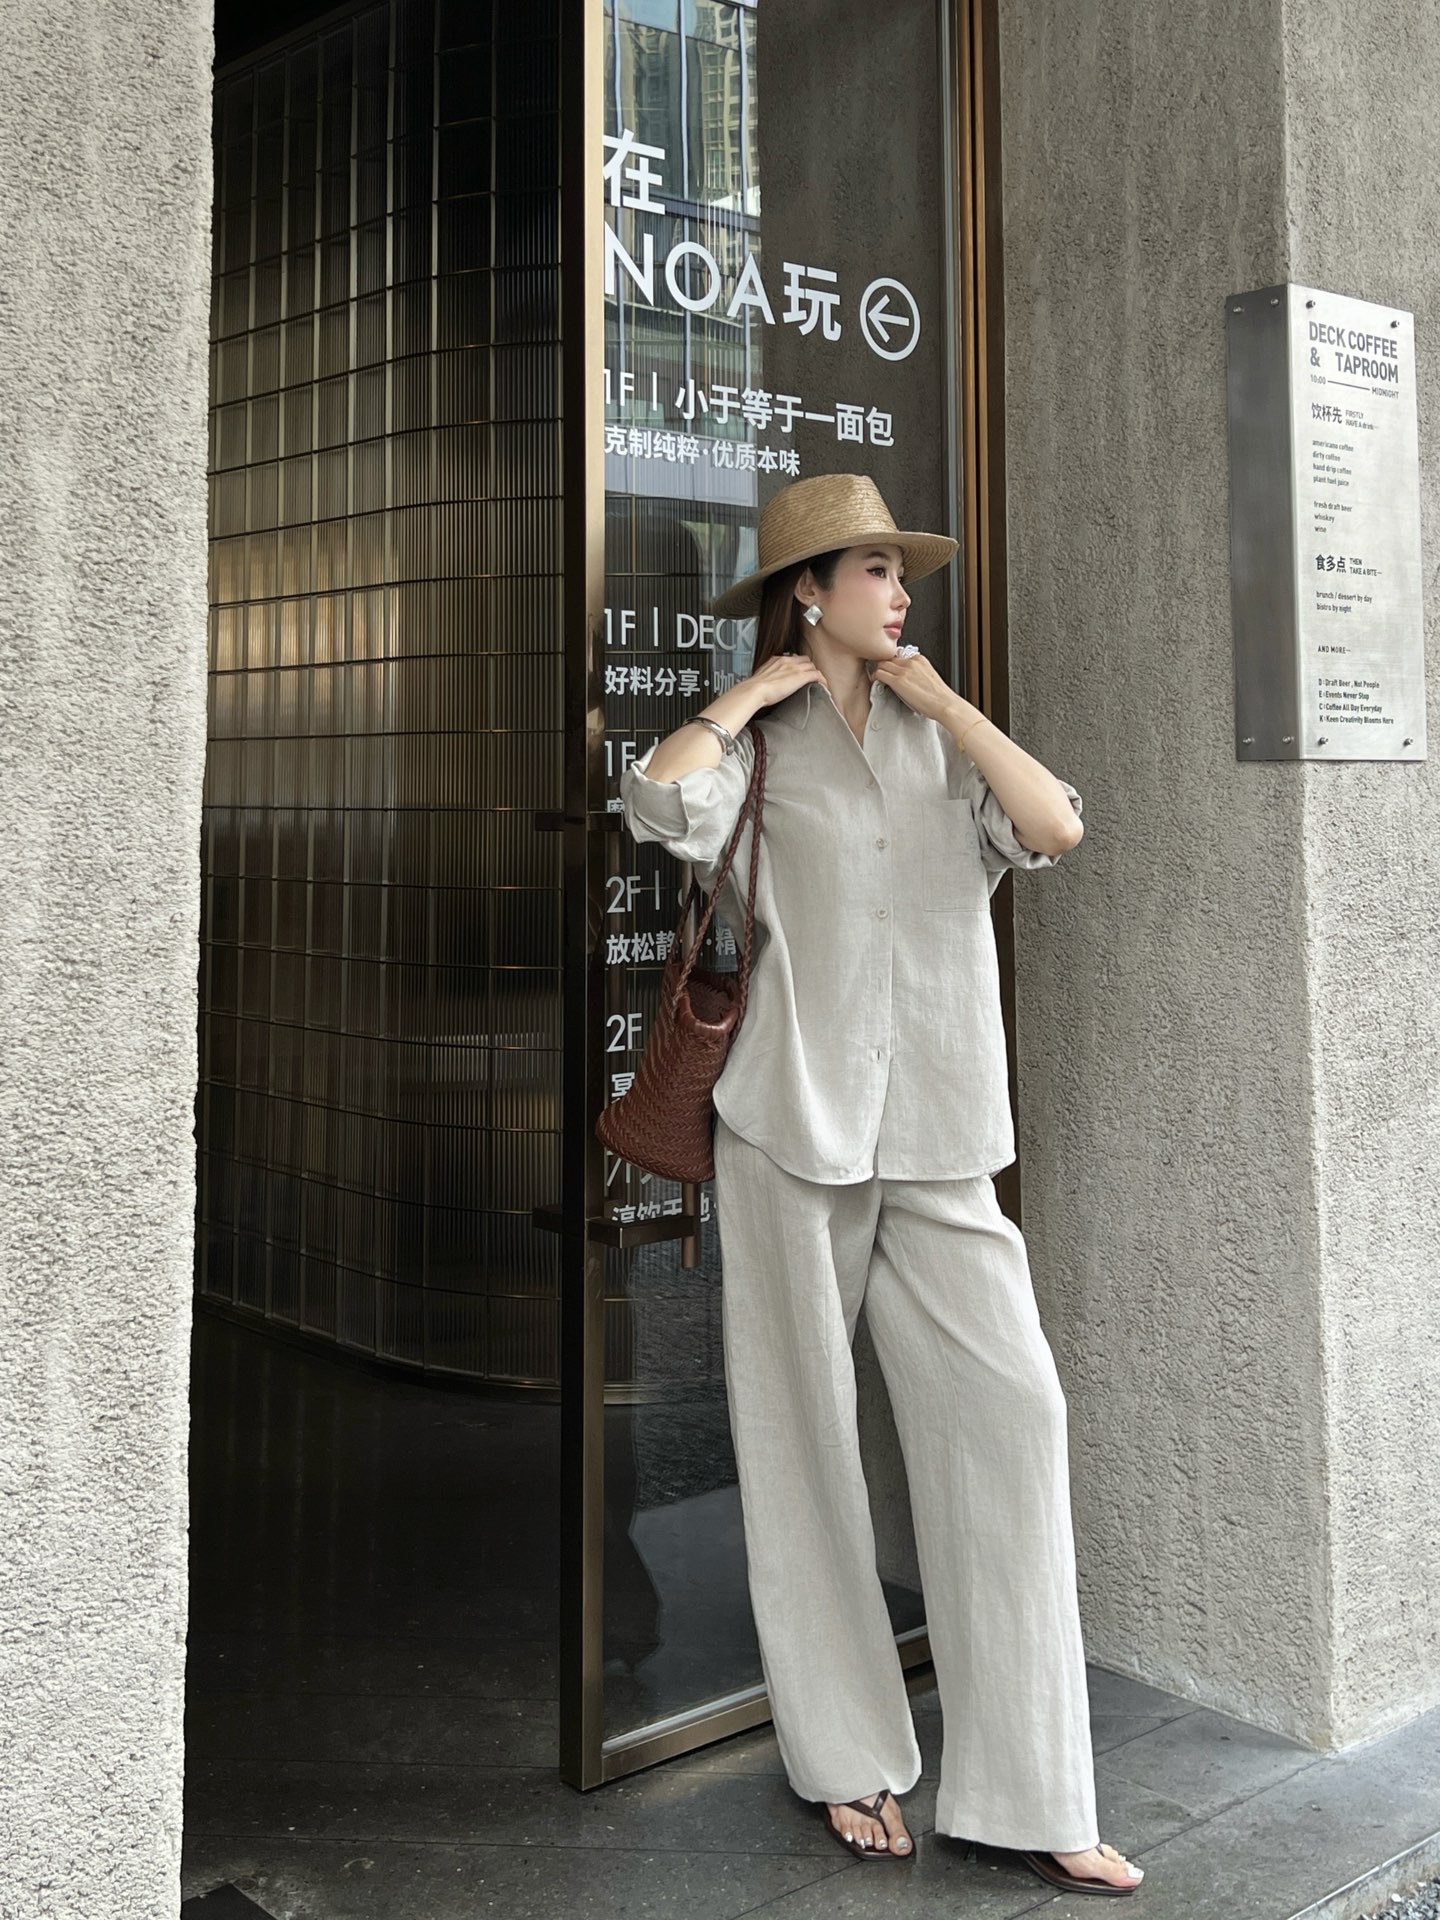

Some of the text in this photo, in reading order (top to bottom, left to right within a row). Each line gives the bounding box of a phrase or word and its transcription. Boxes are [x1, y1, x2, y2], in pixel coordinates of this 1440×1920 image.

[603, 128, 665, 215] 在
[1309, 320, 1398, 359] DECK COFFEE
[1310, 347, 1399, 383] & TAPROOM
[1310, 374, 1399, 399] 10:00 MIDNIGHT
[603, 368, 635, 407] 1F
[675, 378, 895, 447] 小于等于一面包
[1312, 402, 1342, 424] 饮杯先
[604, 426, 801, 477] 克制纯粹·优质本味
[1314, 501, 1327, 509] fresh
[1341, 504, 1352, 512] beer
[1349, 557, 1362, 565] THEN
[1349, 567, 1362, 575] TAKE
[1316, 591, 1334, 599] brunch
[1338, 593, 1356, 601] dessert
[1357, 594, 1362, 603] by
[1364, 595, 1372, 603] day
[1316, 603, 1331, 611] bistro
[1332, 604, 1338, 613] by
[604, 608, 636, 645] 1F
[677, 613, 756, 651] DECK
[1318, 645, 1329, 653] AND
[605, 664, 751, 697] 好料分享·咖
[1364, 681, 1380, 689] People
[1340, 716, 1363, 724] Creativity
[1351, 704, 1359, 713] Day
[1360, 704, 1382, 713] Everyday
[604, 740, 636, 777] 1F
[606, 875, 641, 913] 2F
[606, 1013, 642, 1052] 2F
